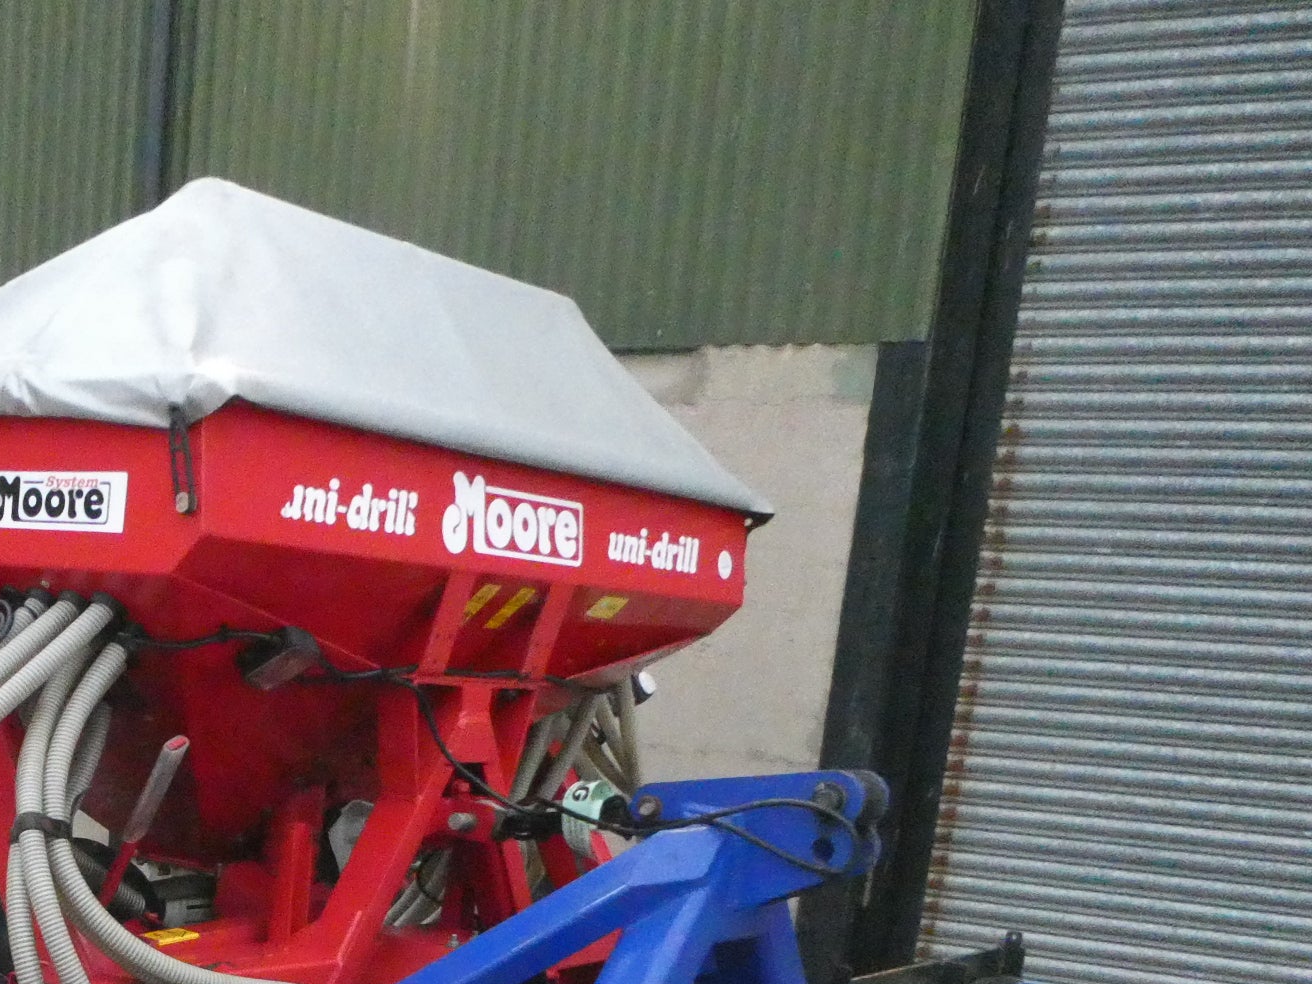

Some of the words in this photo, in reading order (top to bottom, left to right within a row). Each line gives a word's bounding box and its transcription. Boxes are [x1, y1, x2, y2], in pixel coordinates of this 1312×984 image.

[45, 475, 99, 489] System
[441, 470, 579, 559] Moore
[608, 527, 700, 574] uni-drill
